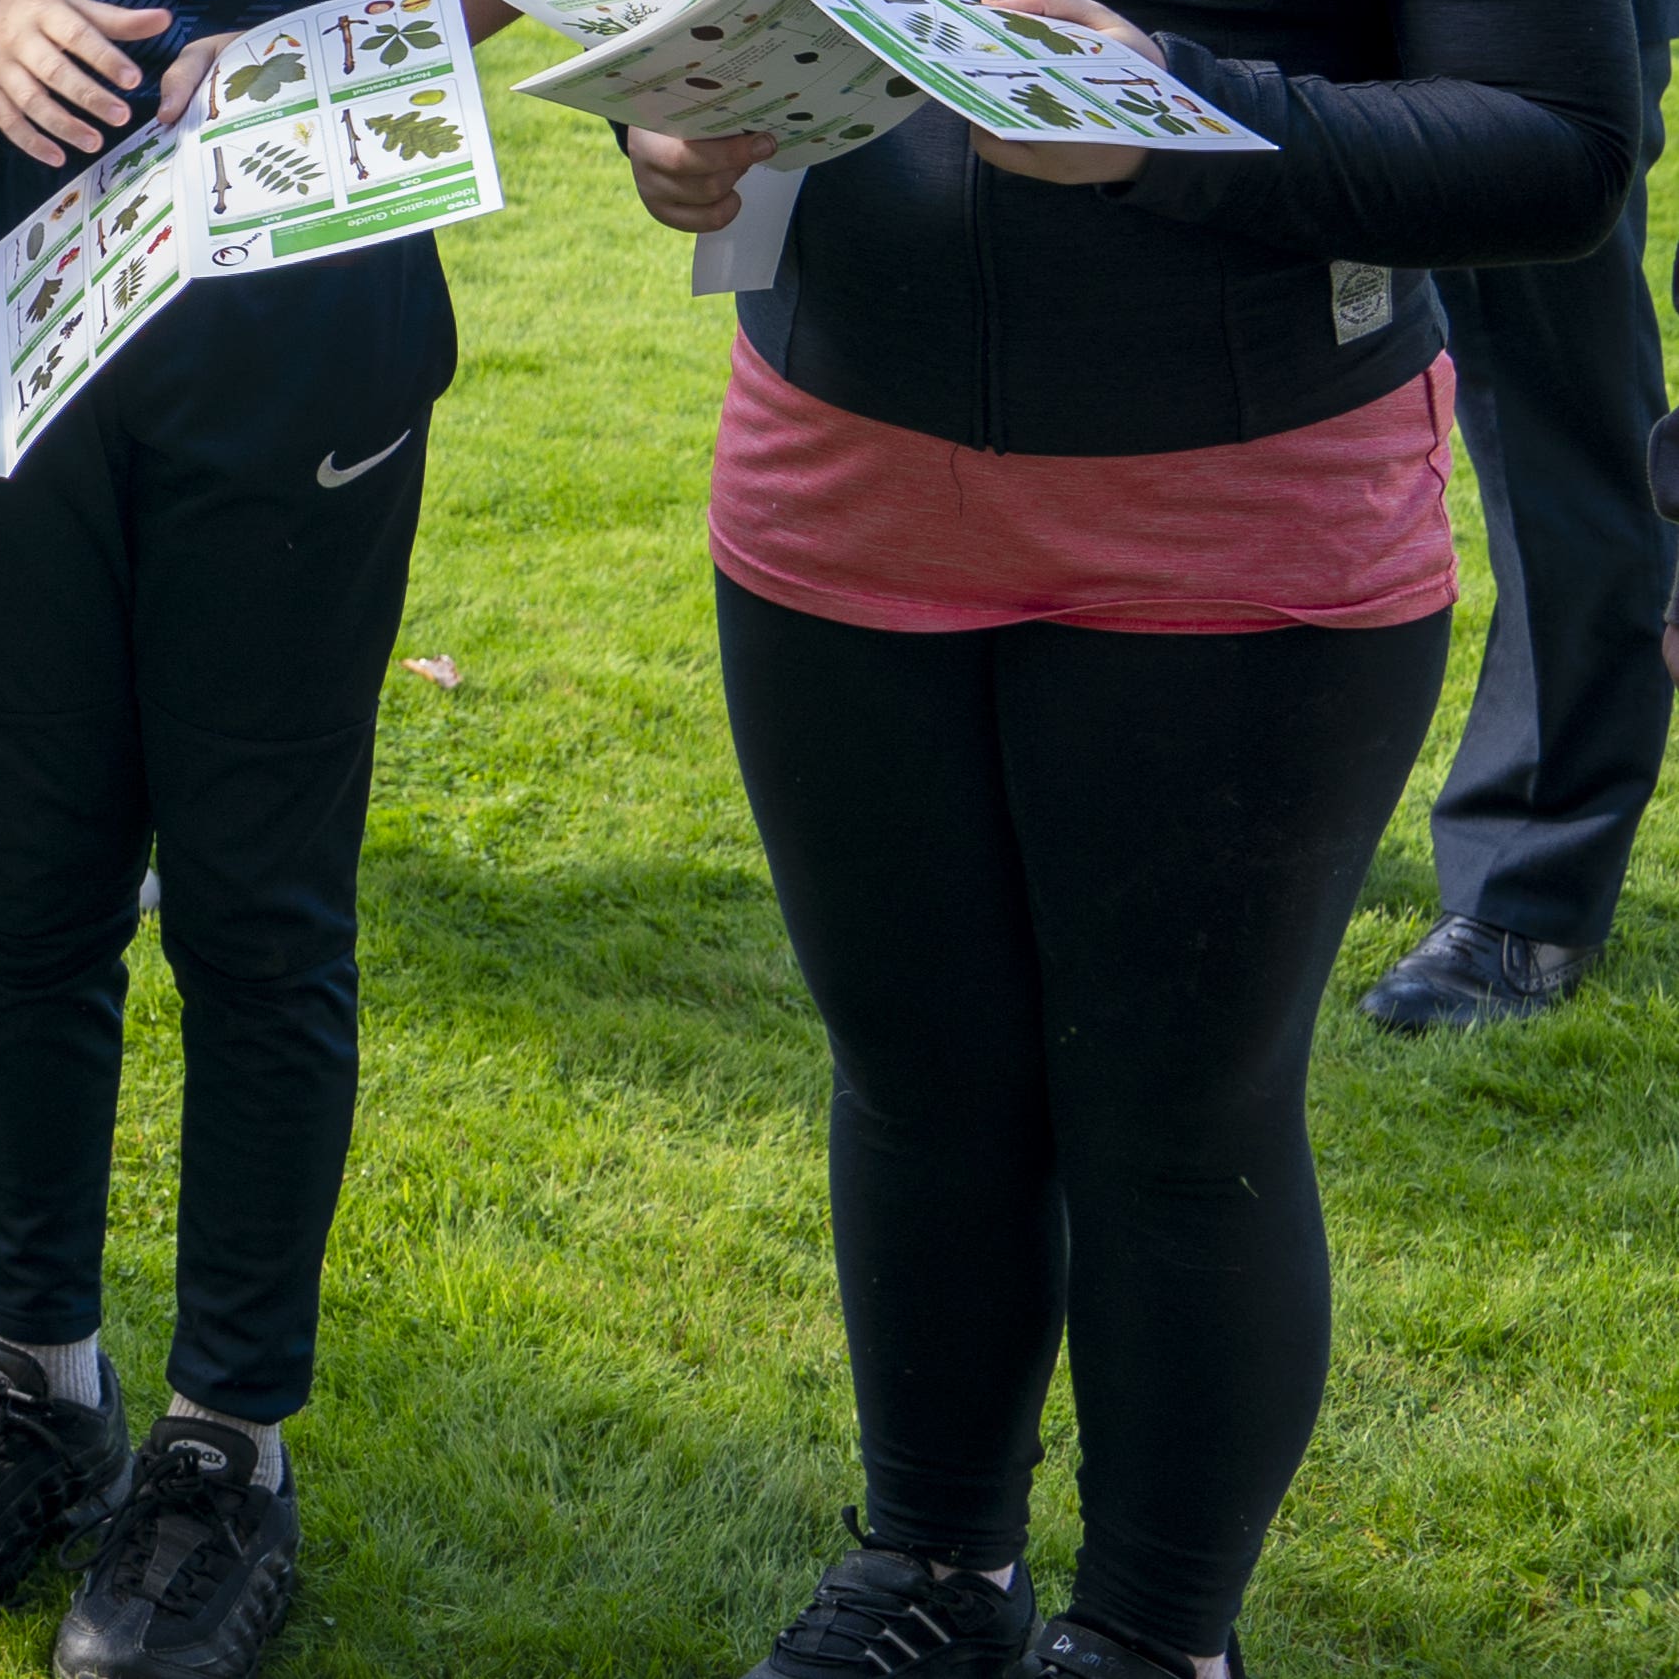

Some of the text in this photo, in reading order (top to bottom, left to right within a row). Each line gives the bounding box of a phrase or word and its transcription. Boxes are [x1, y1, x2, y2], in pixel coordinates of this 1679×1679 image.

[352, 71, 431, 96] Horse chestnut
[232, 109, 284, 129] Sycamore
[398, 177, 422, 188] Oak
[390, 187, 477, 216] Identification
[446, 197, 479, 212] Tree
[347, 211, 389, 228] Guide
